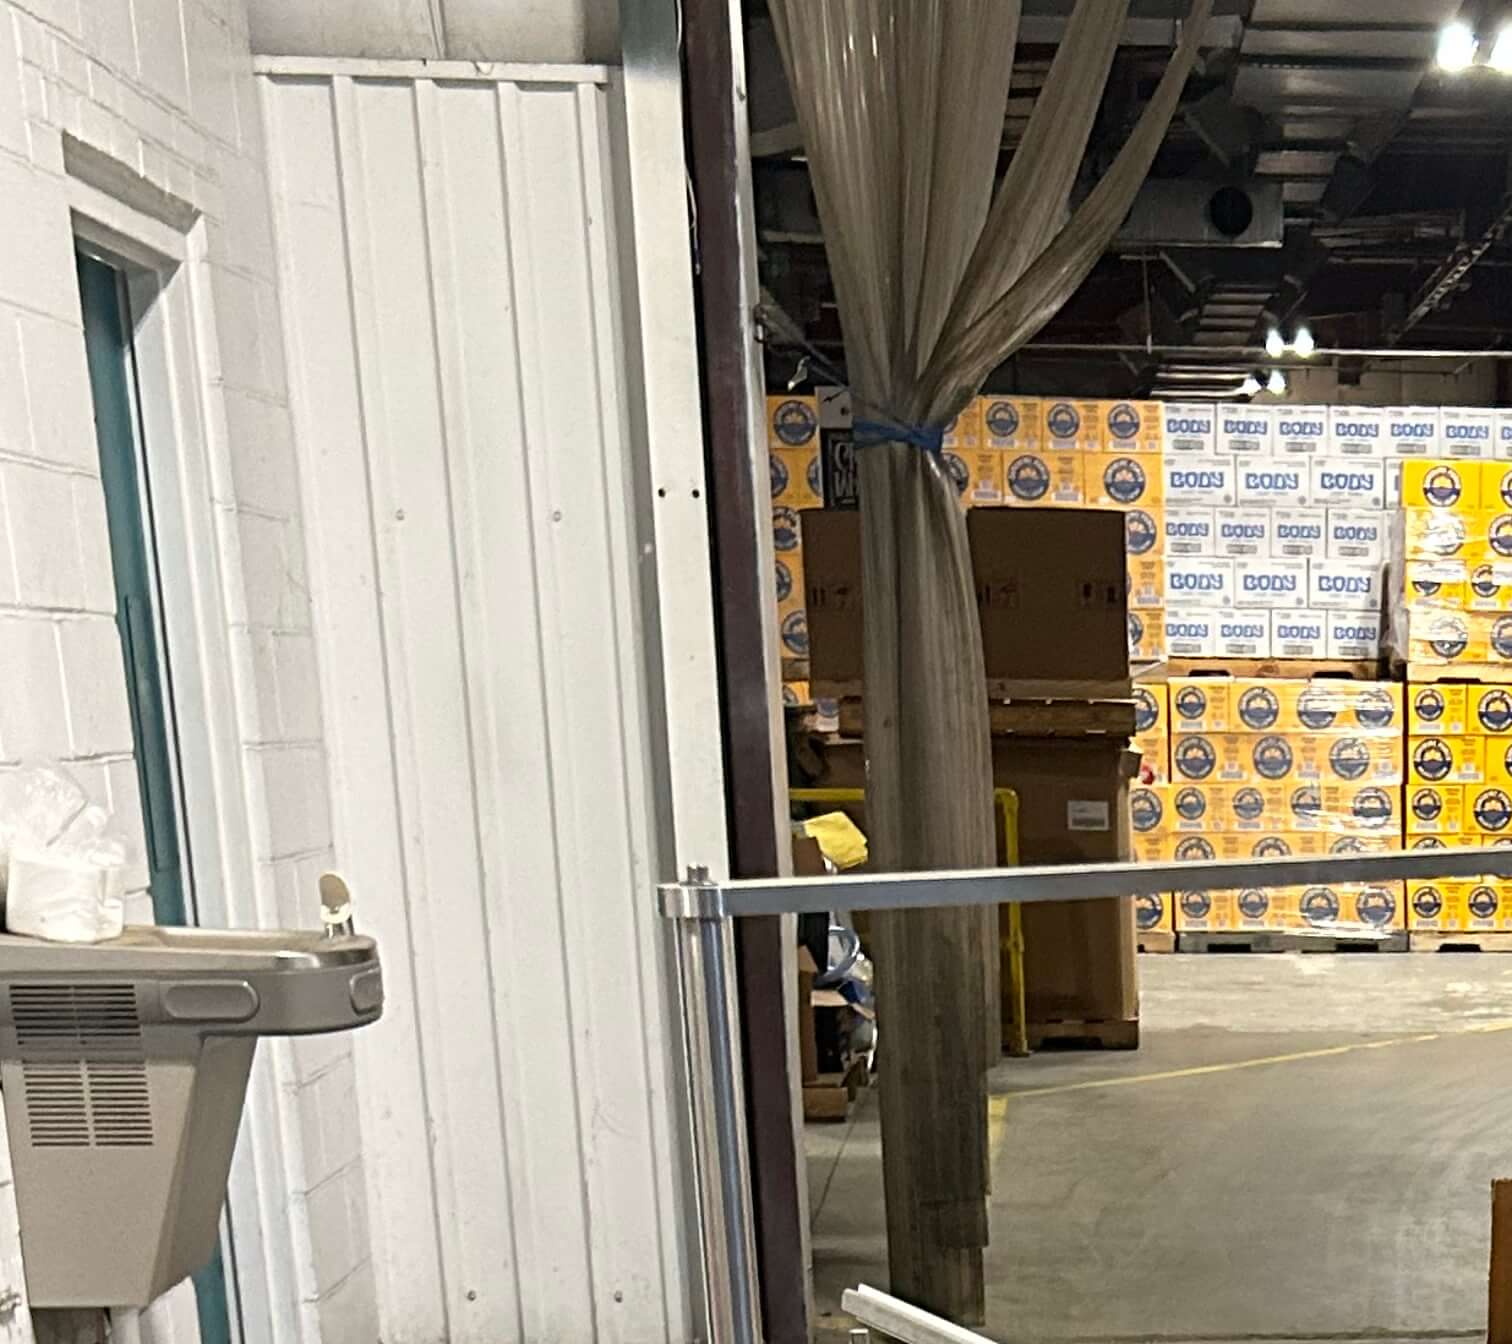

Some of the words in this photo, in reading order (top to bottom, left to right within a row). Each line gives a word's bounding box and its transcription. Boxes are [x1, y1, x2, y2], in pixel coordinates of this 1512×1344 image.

[1167, 419, 1210, 433] BODY
[1224, 420, 1267, 435] BODY
[1280, 421, 1322, 436] BODY
[1336, 423, 1378, 438] BODY
[1391, 423, 1434, 438] BODY
[1446, 425, 1488, 440] BODY
[1171, 472, 1224, 488] BODY
[1246, 474, 1298, 490] BODY
[1321, 474, 1373, 490] BODY
[1166, 523, 1209, 538] BODY
[1222, 525, 1263, 540] BODY
[1278, 525, 1320, 540] BODY
[1334, 527, 1377, 542] BODY
[1170, 574, 1223, 590] BODY
[1244, 576, 1296, 592] BODY
[1319, 576, 1371, 592] BODY
[1166, 624, 1209, 639] BODY
[1221, 624, 1262, 639] BODY
[1278, 625, 1320, 640] BODY
[1334, 627, 1376, 641] BODY
